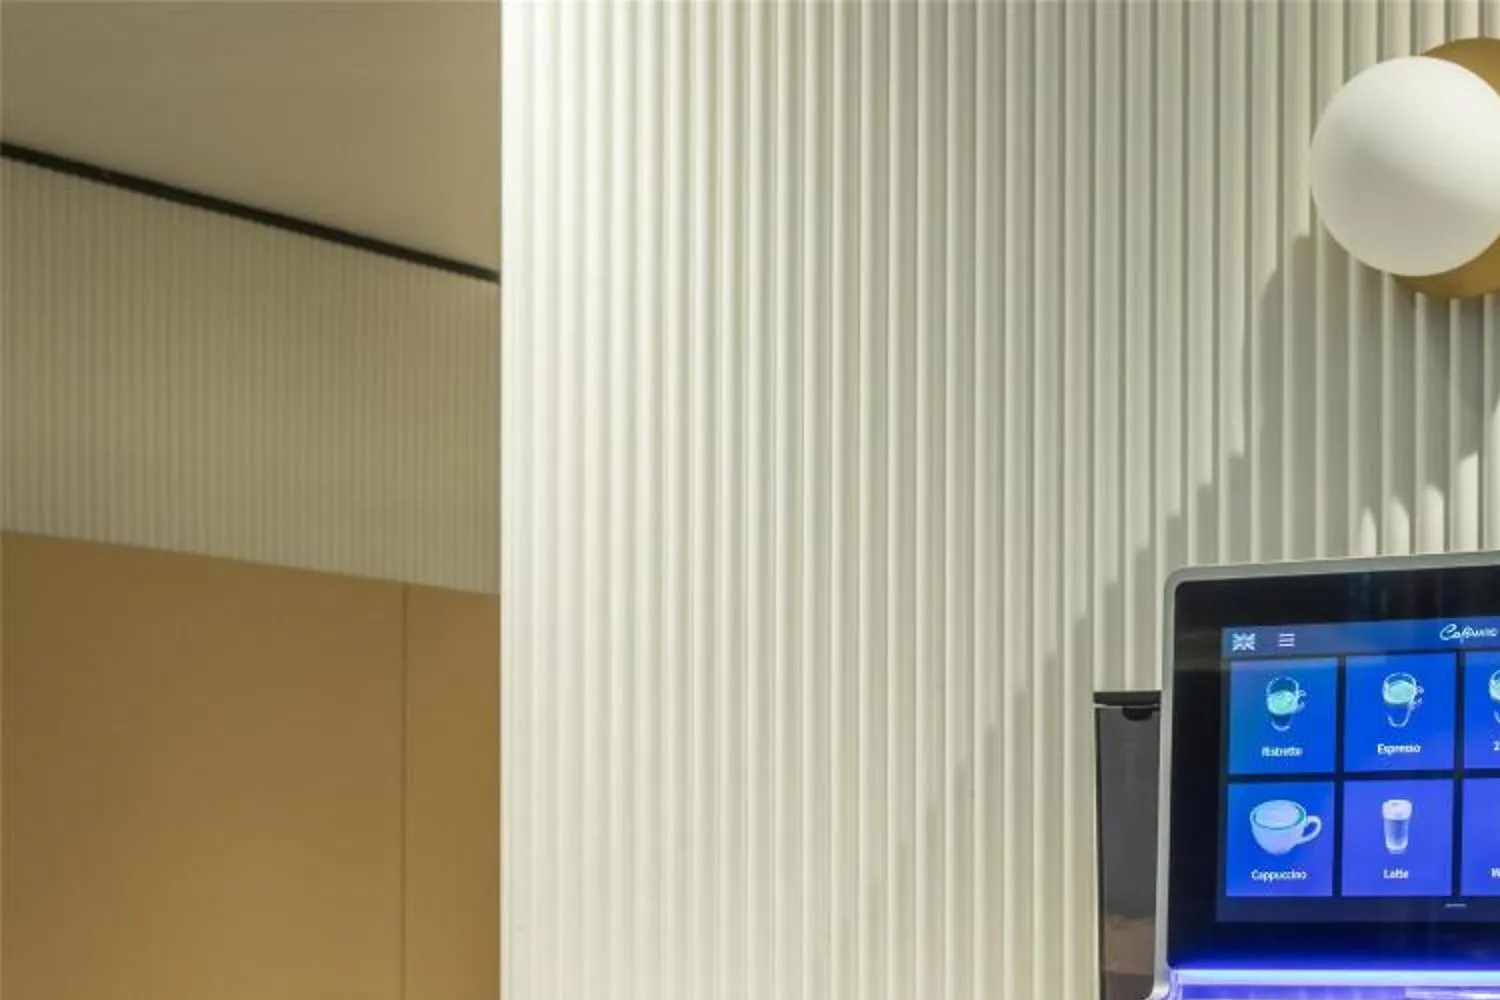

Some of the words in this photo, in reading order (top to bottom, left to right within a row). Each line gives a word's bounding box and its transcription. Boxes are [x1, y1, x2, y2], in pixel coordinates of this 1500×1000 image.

[1376, 743, 1422, 756] Espresso
[1251, 868, 1308, 883] Cappuccino
[1383, 868, 1409, 879] Latte
